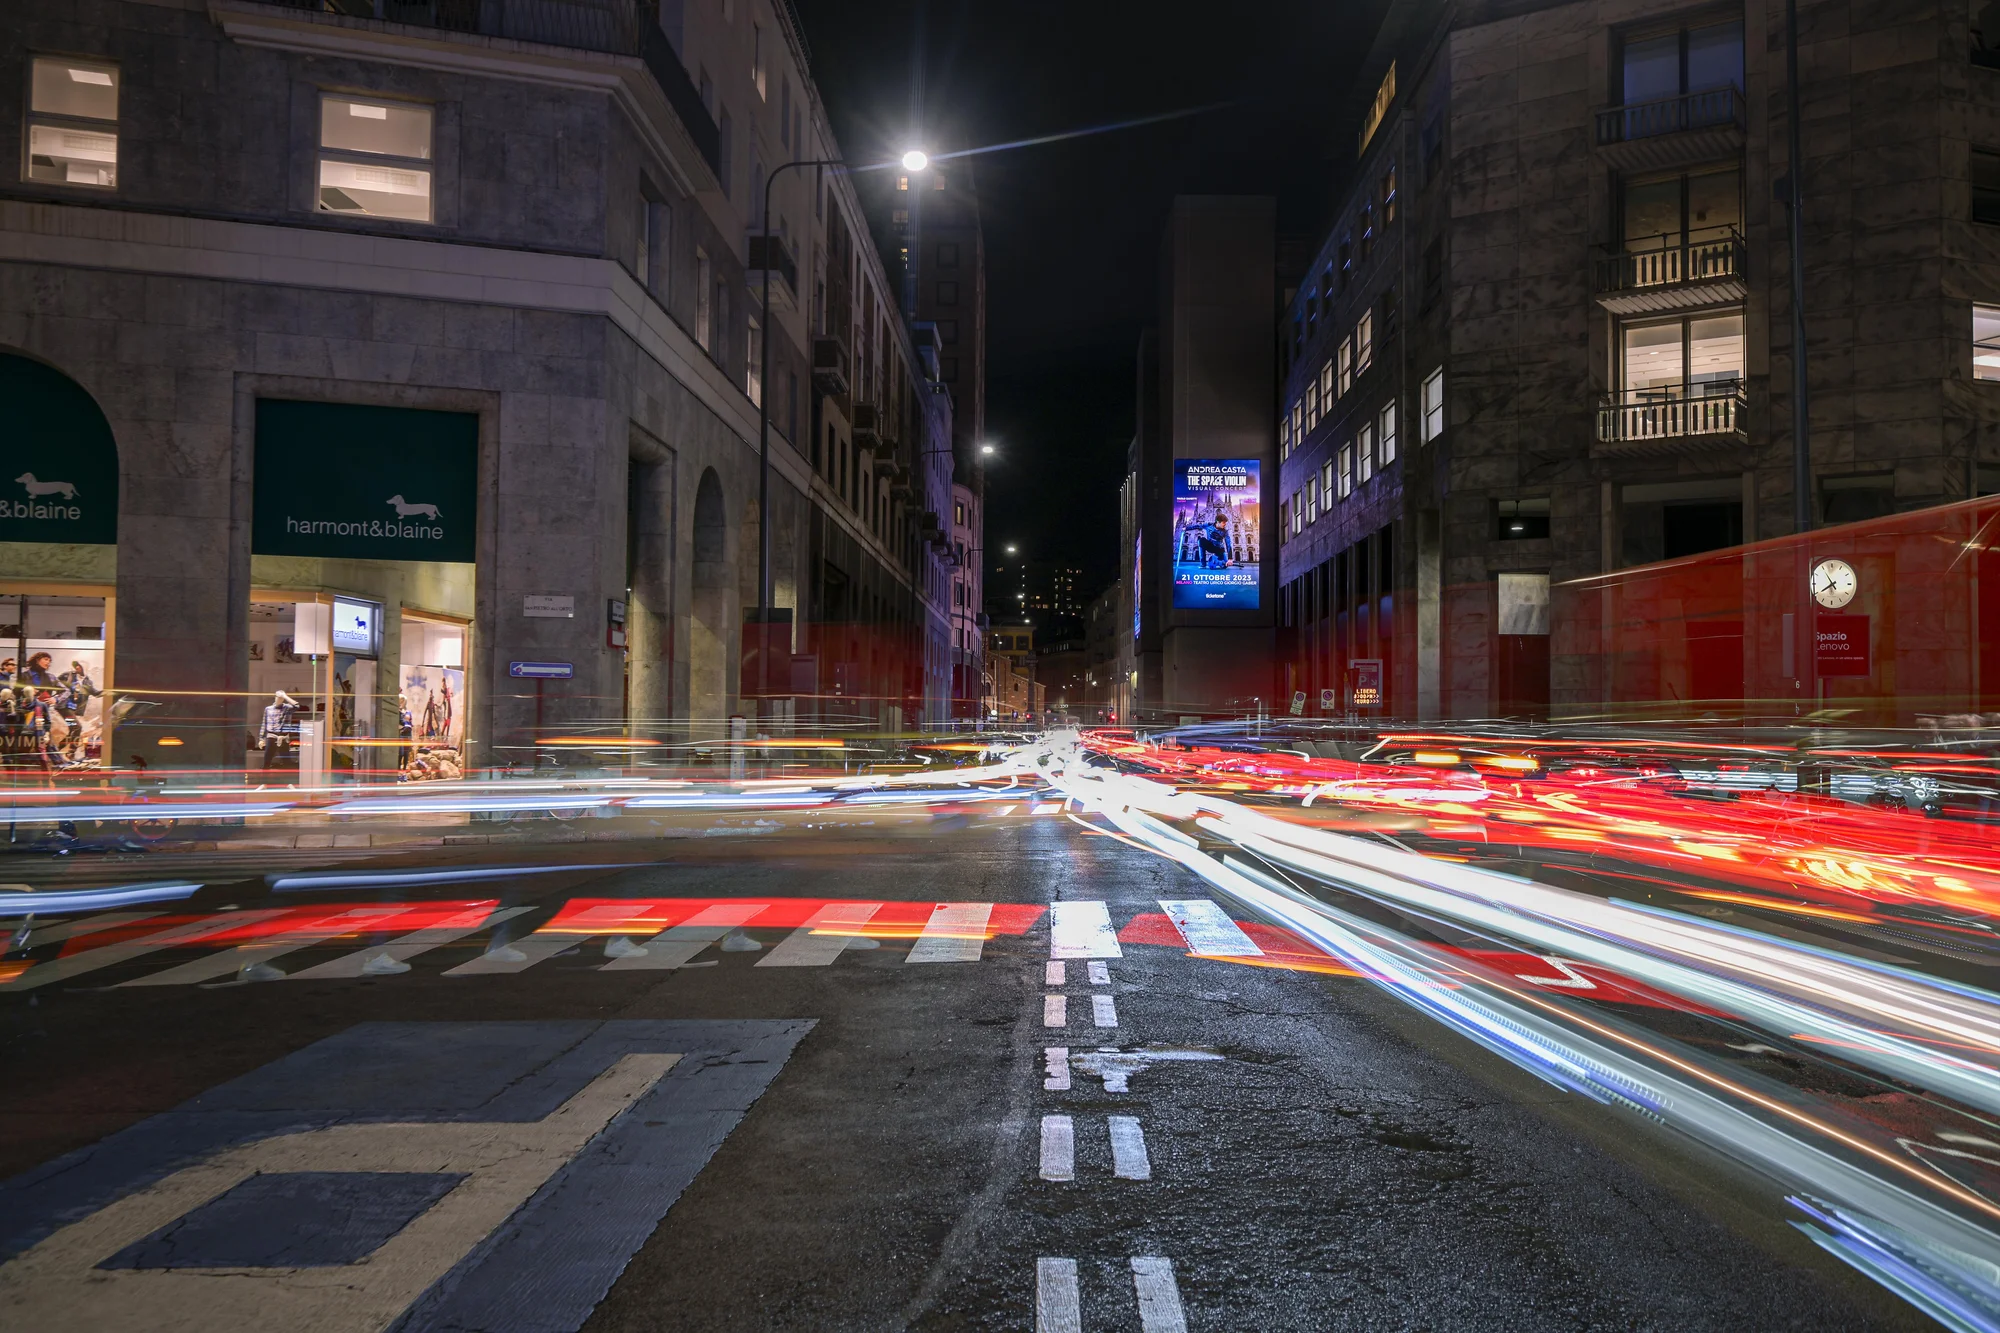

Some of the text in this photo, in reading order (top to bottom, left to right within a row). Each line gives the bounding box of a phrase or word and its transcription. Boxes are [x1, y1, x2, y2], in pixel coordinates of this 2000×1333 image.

[1188, 476, 1246, 486] THE SPACE VIOLIN
[286, 516, 444, 541] harmont&blaine
